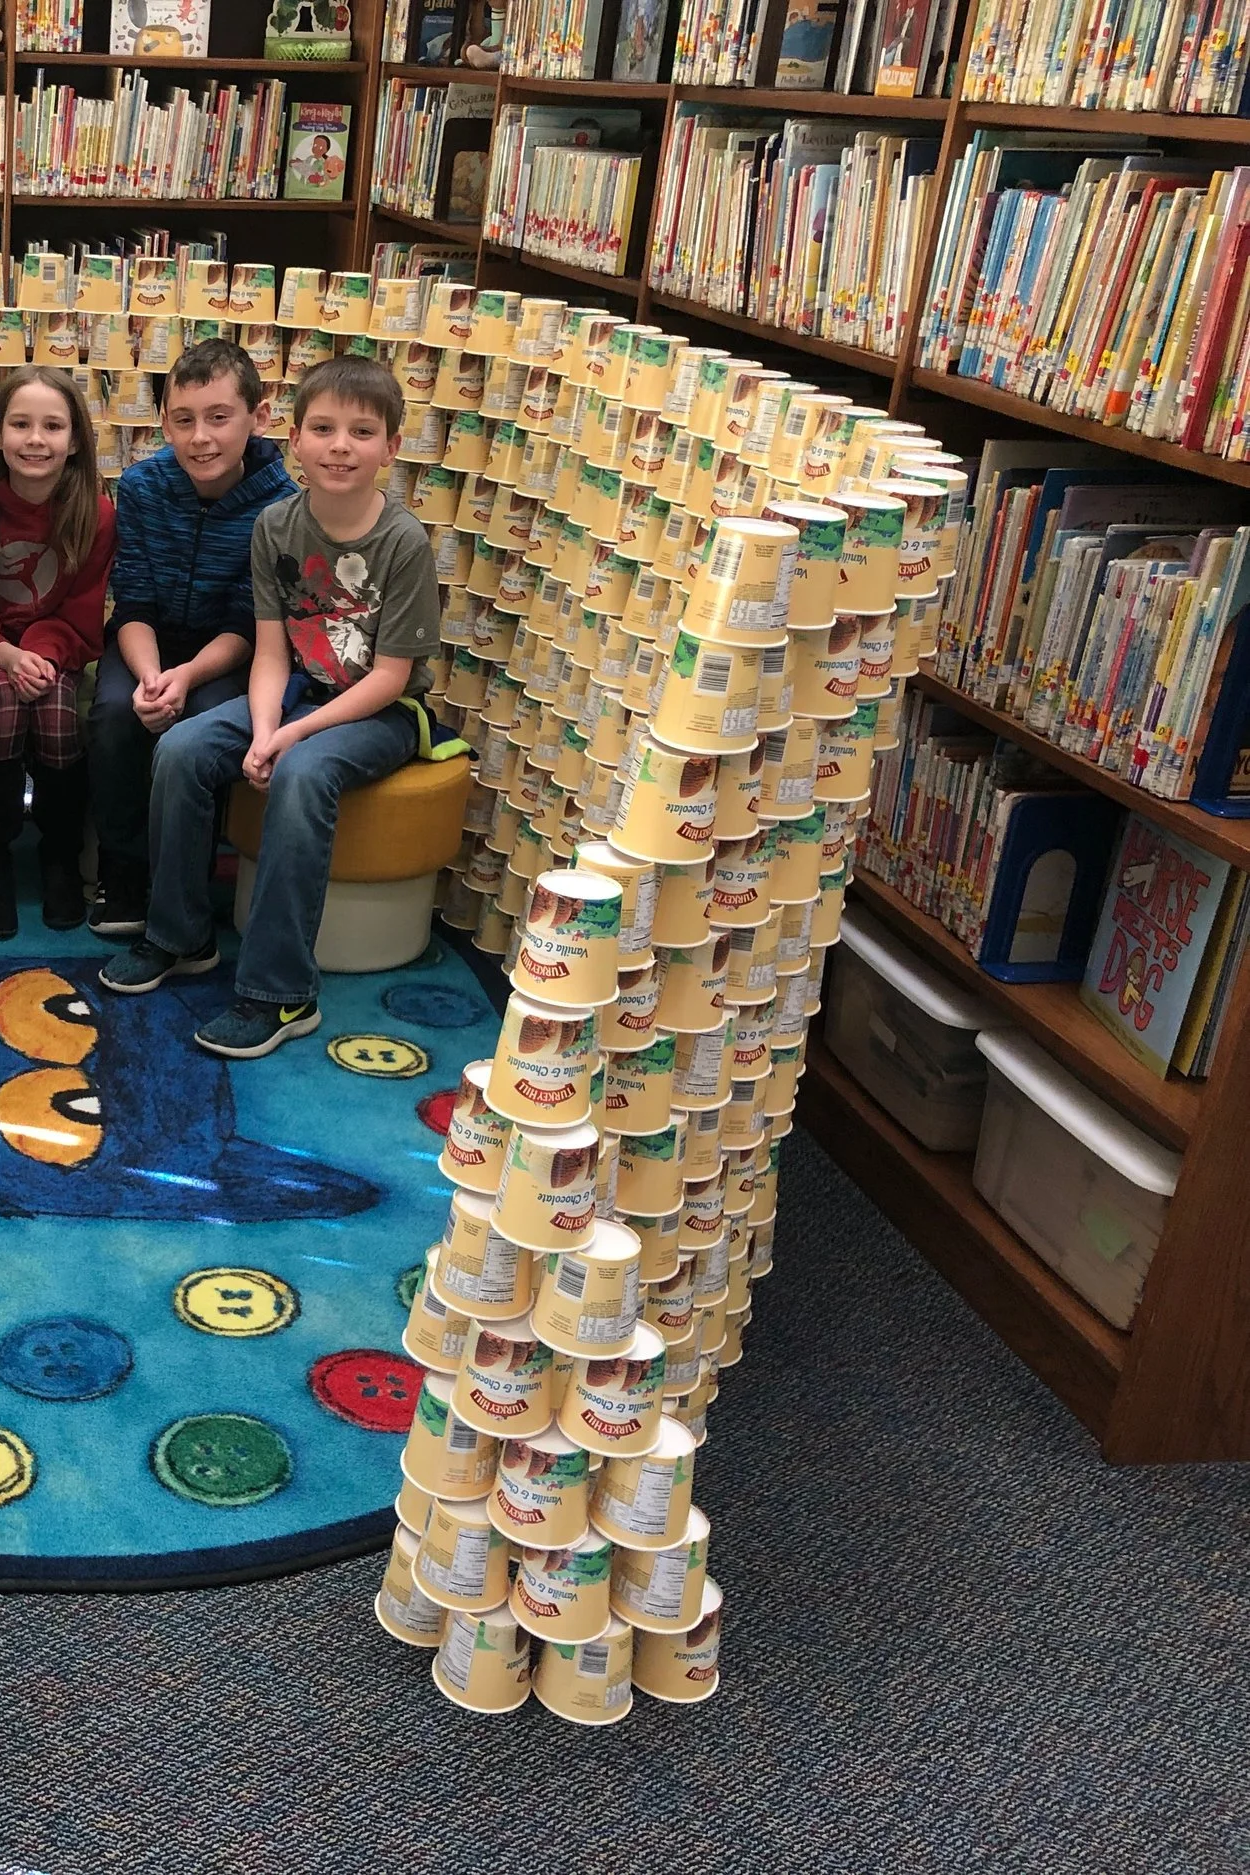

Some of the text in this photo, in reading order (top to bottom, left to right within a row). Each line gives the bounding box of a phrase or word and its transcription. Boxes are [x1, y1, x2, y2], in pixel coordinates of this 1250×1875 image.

[815, 660, 854, 671] Chocolate
[832, 682, 846, 695] HILL
[827, 745, 856, 757] Vanilla
[665, 803, 706, 814] Chocolate
[683, 826, 698, 840] HILL
[721, 890, 756, 904] TURKEY
[1112, 892, 1181, 972] MEETS
[556, 945, 588, 958] Vanilla
[522, 952, 566, 977] TURKEY HILL
[623, 1016, 638, 1028] HILL
[507, 1055, 548, 1076] Chocolate
[616, 1077, 645, 1091] Vanilla
[520, 1082, 574, 1103] TURKEY HILL
[474, 1132, 503, 1148] Vanilla
[538, 1193, 581, 1204] Chocolate
[556, 1214, 573, 1228] HILL
[466, 1364, 500, 1390] Chocolate
[515, 1382, 542, 1394] Vanilla
[474, 1392, 526, 1414] TURKEY HILL
[575, 1384, 613, 1410] Chocolate
[628, 1402, 654, 1415] Vanilla
[585, 1412, 640, 1435] TURKEY HILL
[531, 1494, 562, 1506] Vanilla
[511, 1507, 543, 1523] TURKEY
[547, 1588, 578, 1601] Vanilla
[526, 1596, 558, 1616] TURKEY
